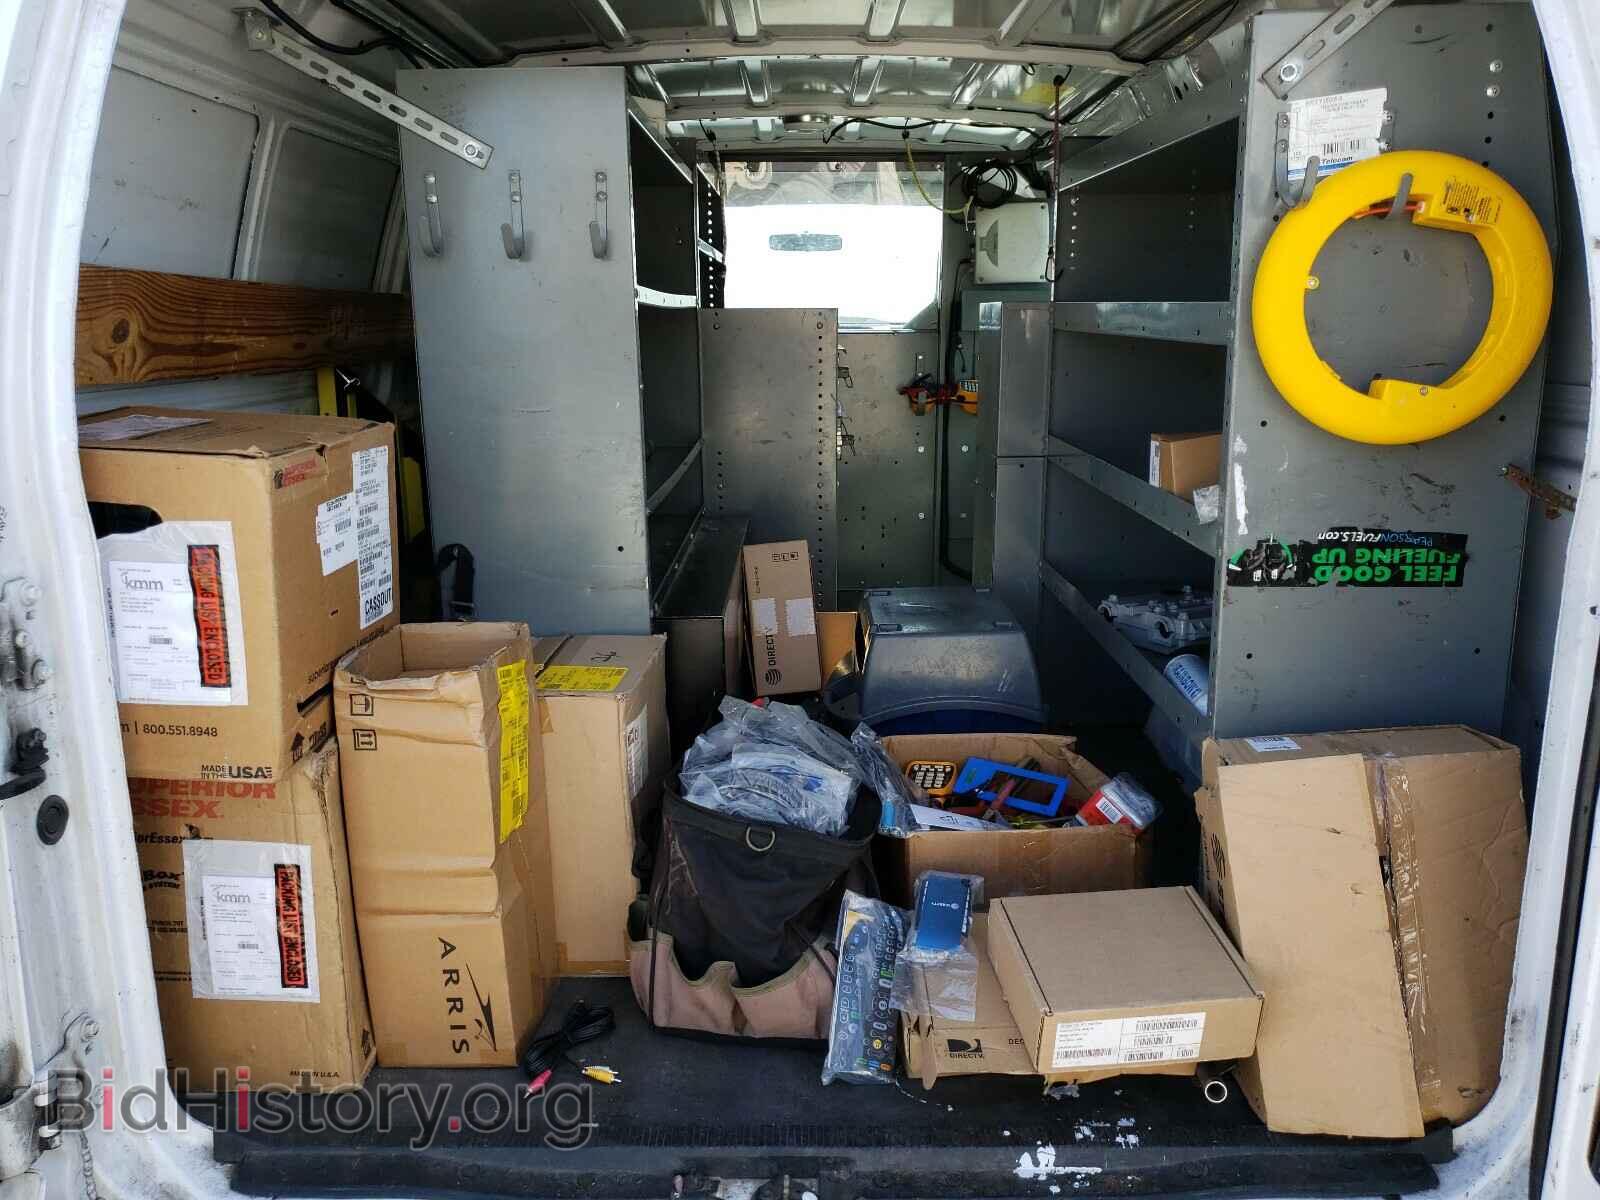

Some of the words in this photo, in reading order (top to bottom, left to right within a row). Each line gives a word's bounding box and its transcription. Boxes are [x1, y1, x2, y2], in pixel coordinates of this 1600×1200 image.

[1311, 547, 1346, 564] UP
[1355, 547, 1461, 564] FUELING
[1313, 565, 1391, 582] GOOD
[1400, 565, 1457, 582] FEEL
[365, 588, 391, 615] CASSOUT
[143, 723, 218, 737] 800.551.8948
[201, 764, 226, 772] MADE
[229, 766, 267, 779] USA
[134, 799, 220, 819] SSEX
[216, 891, 251, 903] kmm
[438, 937, 470, 1054] ARRIS
[949, 1051, 982, 1059] DIRECTV
